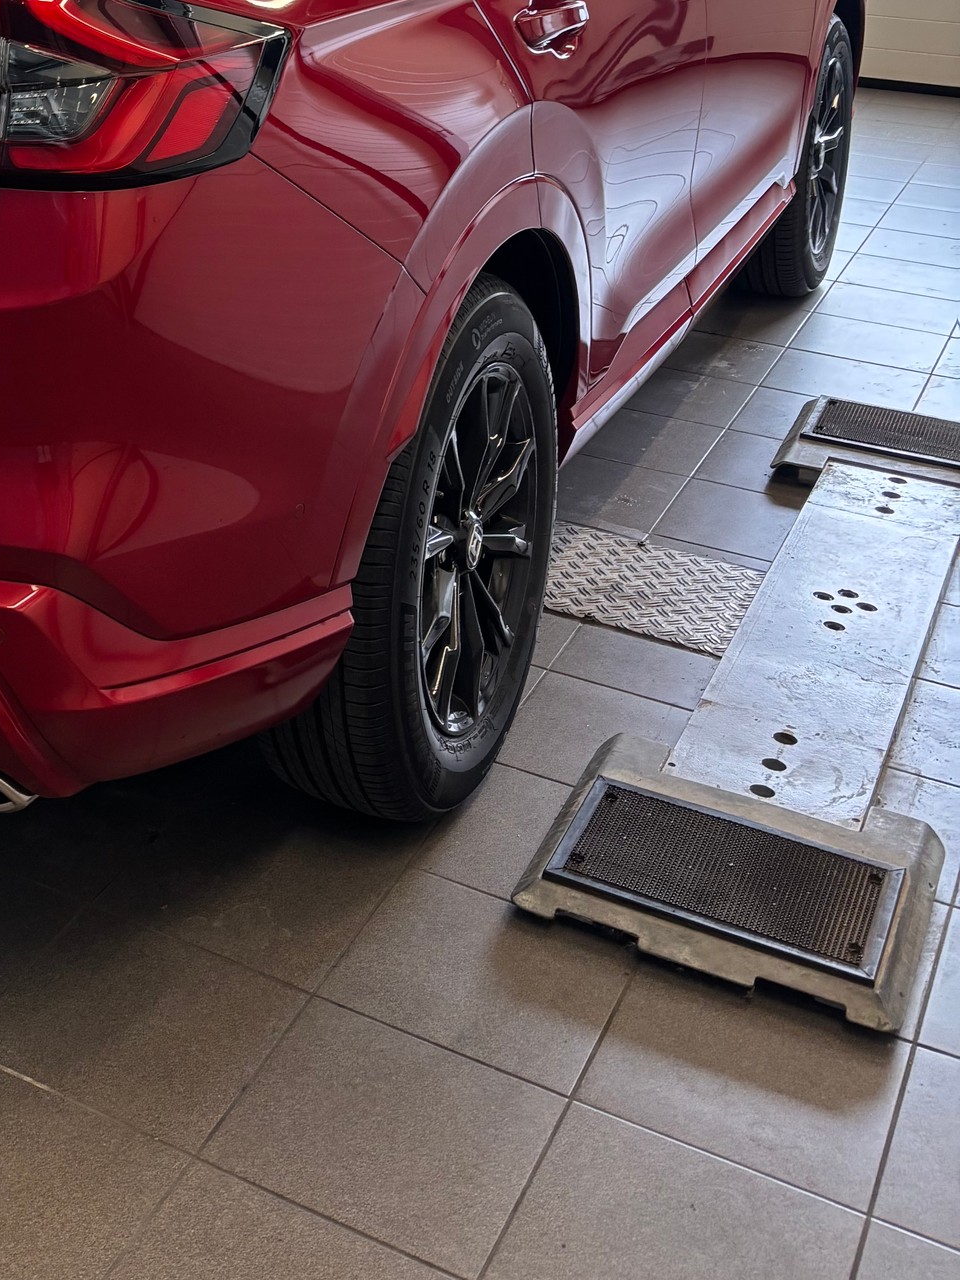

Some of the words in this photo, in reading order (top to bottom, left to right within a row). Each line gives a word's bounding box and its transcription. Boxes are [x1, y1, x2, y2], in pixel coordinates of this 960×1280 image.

[409, 501, 426, 582] 235/60
[422, 479, 431, 496] R
[427, 450, 437, 473] 18
